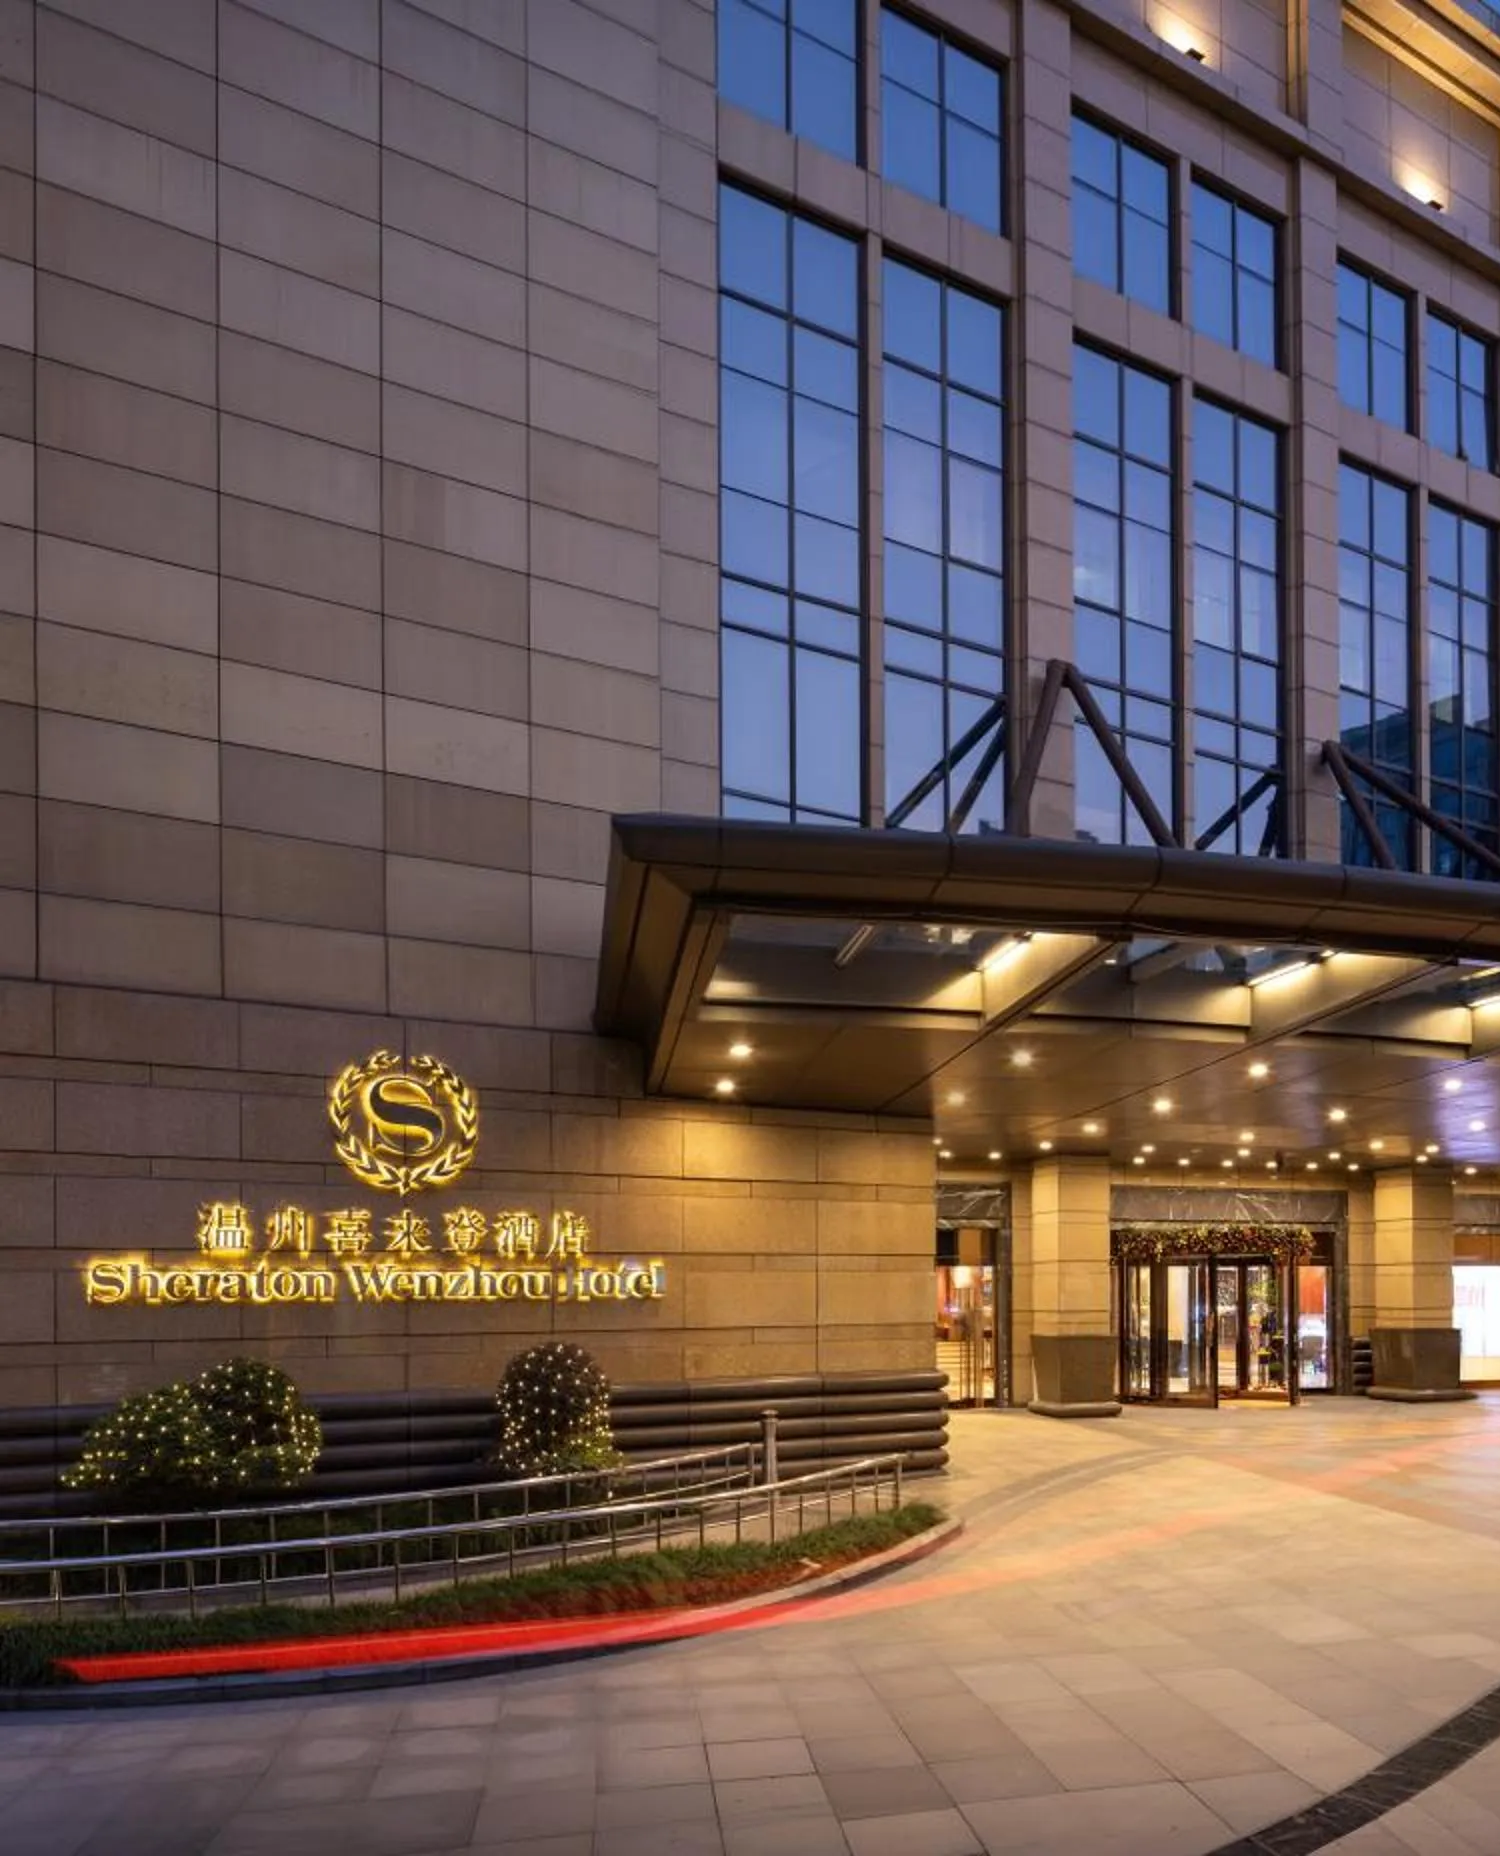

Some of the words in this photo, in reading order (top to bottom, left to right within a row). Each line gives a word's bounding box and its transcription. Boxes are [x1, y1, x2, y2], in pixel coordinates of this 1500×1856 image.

[368, 1076, 445, 1157] S
[197, 1204, 590, 1258] 温州喜来登酒店
[88, 1259, 337, 1303] Sheraton
[344, 1261, 552, 1301] Wenzhou
[557, 1260, 666, 1301] Hotel
